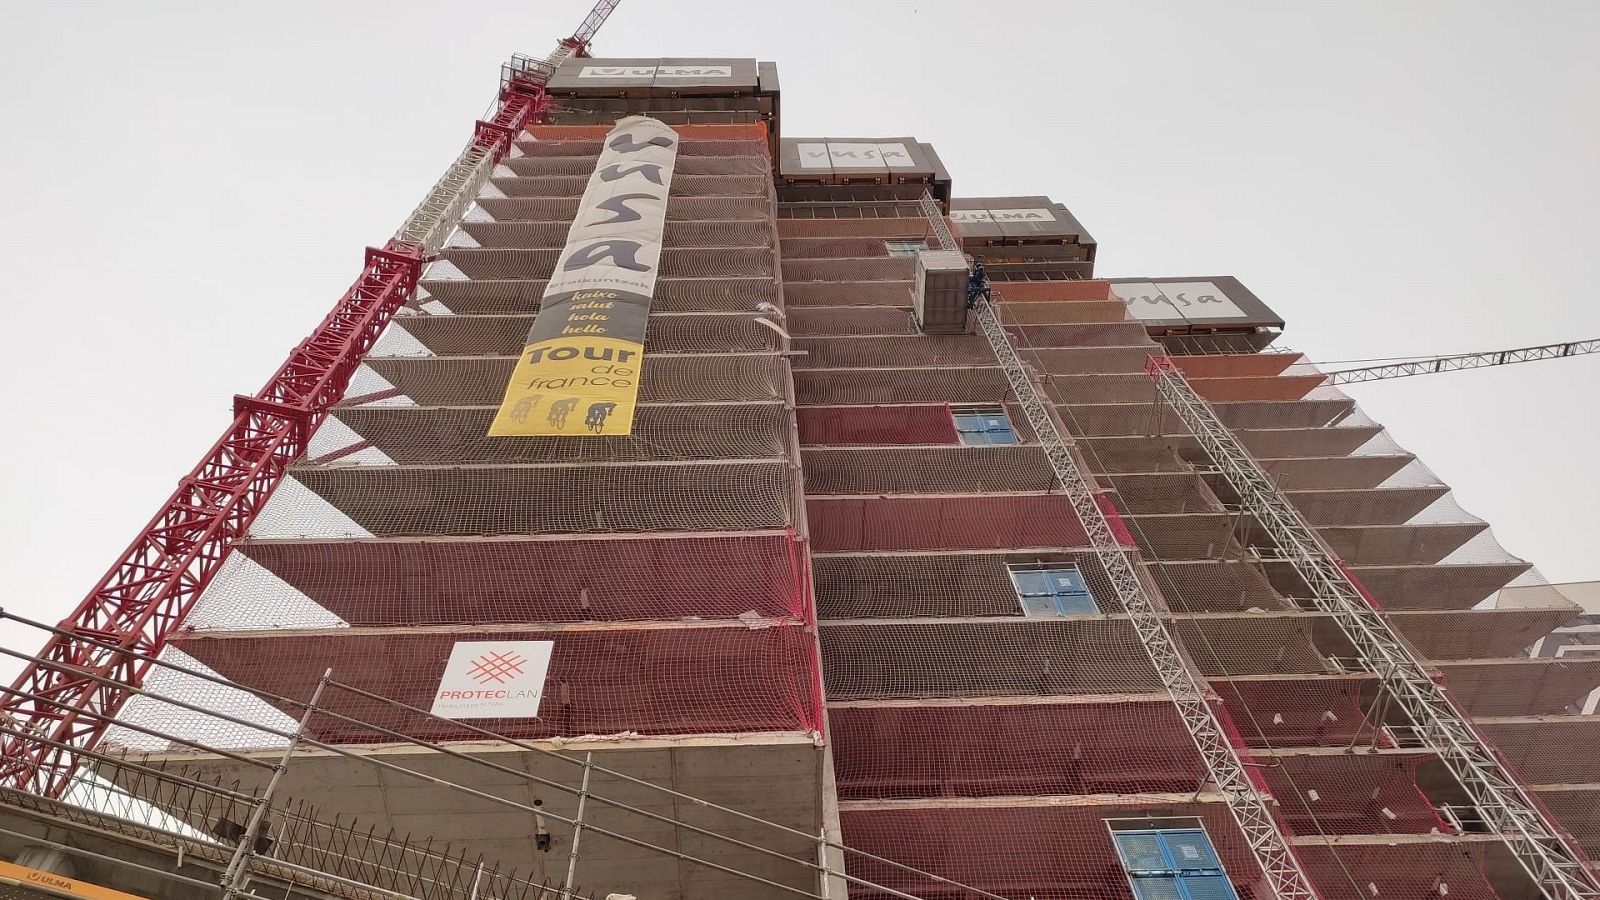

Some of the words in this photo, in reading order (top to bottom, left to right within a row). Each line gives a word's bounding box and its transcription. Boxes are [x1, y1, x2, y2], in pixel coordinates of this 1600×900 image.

[631, 68, 727, 76] ULMA
[970, 212, 1043, 220] ULMA
[549, 278, 651, 290] eraikuntzak
[571, 290, 618, 301] kaixo
[569, 301, 615, 310] salut
[567, 312, 610, 321] hola
[561, 324, 609, 334] hello
[527, 347, 636, 365] Tour
[591, 364, 633, 376] de
[527, 376, 632, 390] france
[439, 689, 539, 700] PROTECLAN
[40, 876, 72, 890] ULMA
